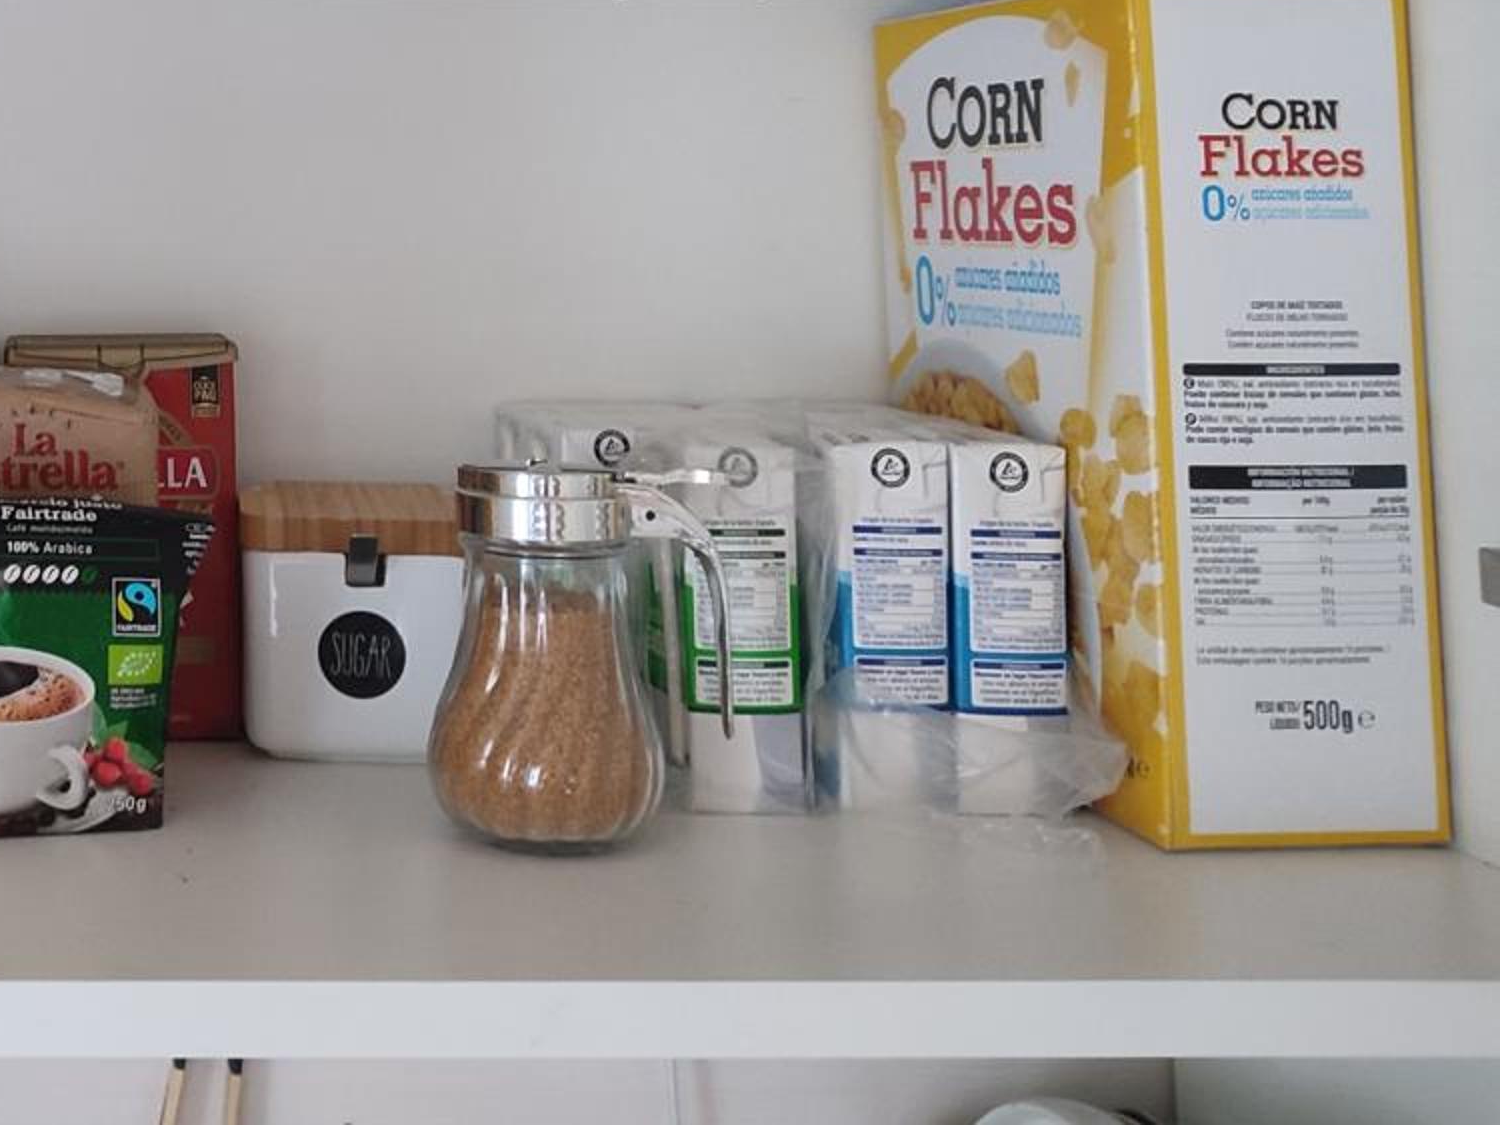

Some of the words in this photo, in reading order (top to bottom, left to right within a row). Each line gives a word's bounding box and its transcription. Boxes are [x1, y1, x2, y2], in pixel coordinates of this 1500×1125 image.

[928, 77, 1045, 150] CORN
[1221, 92, 1339, 131] CORN
[1198, 134, 1365, 177] Flakes
[910, 157, 1078, 245] Flakes
[1202, 184, 1251, 222] 0%
[915, 255, 957, 326] 0%
[13, 423, 57, 456] La
[0, 505, 98, 522] Fairtrade
[7, 540, 40, 555] 100%
[330, 630, 393, 679] SUGAR
[1303, 699, 1353, 734] 500g
